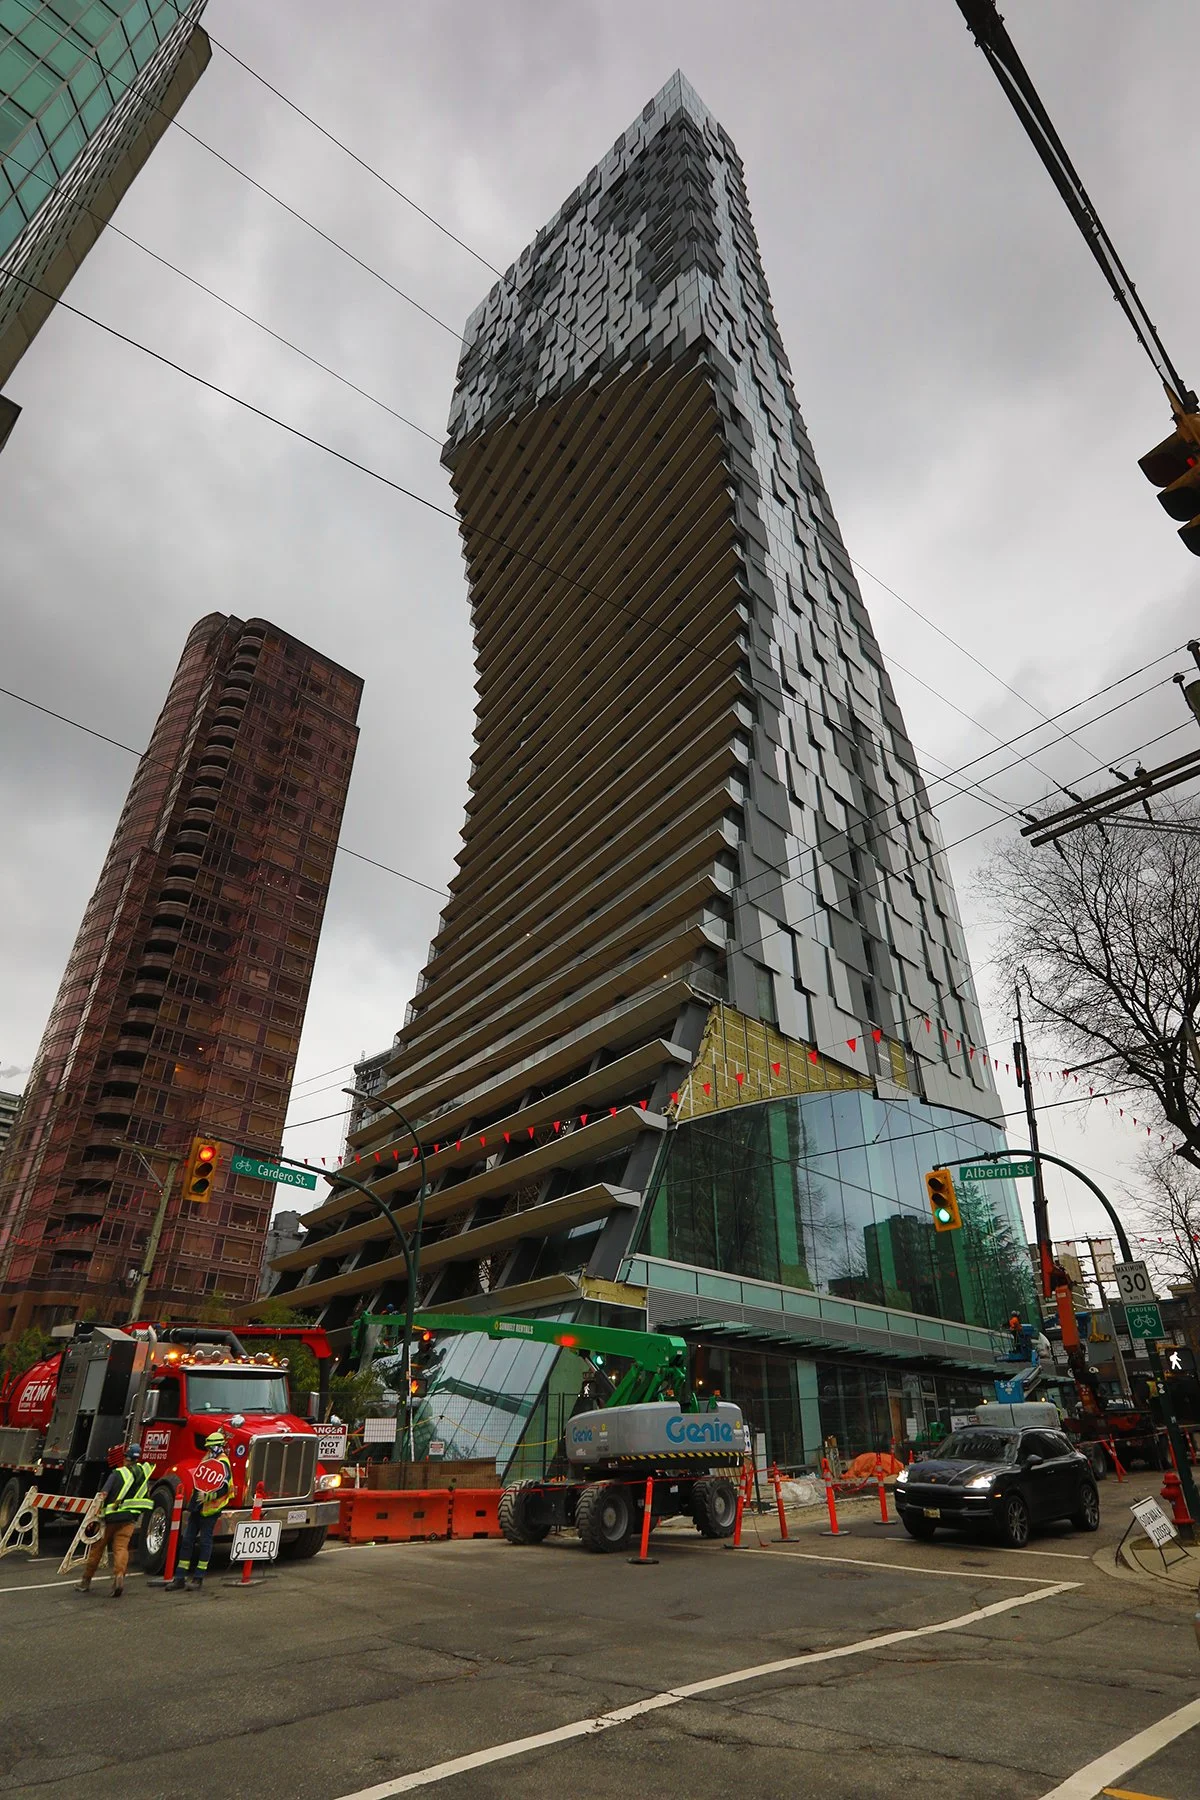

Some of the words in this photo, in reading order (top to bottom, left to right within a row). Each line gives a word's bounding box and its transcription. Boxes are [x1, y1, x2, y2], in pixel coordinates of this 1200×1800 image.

[257, 1164, 294, 1183] Cardero
[295, 1175, 308, 1186] St.
[965, 1165, 1012, 1179] Alberni
[1017, 1164, 1030, 1175] St
[1116, 1264, 1144, 1273] MAXIMUM
[1121, 1273, 1147, 1294] 30
[1127, 1306, 1157, 1314] CARDERO
[572, 1425, 593, 1443] Genie
[665, 1415, 733, 1444] Genie
[195, 1465, 224, 1485] STOP
[1139, 1507, 1162, 1527] SIDEWALK
[243, 1526, 272, 1539] ROAD
[1152, 1523, 1171, 1541] CLOSED
[235, 1541, 276, 1554] CLOSED
